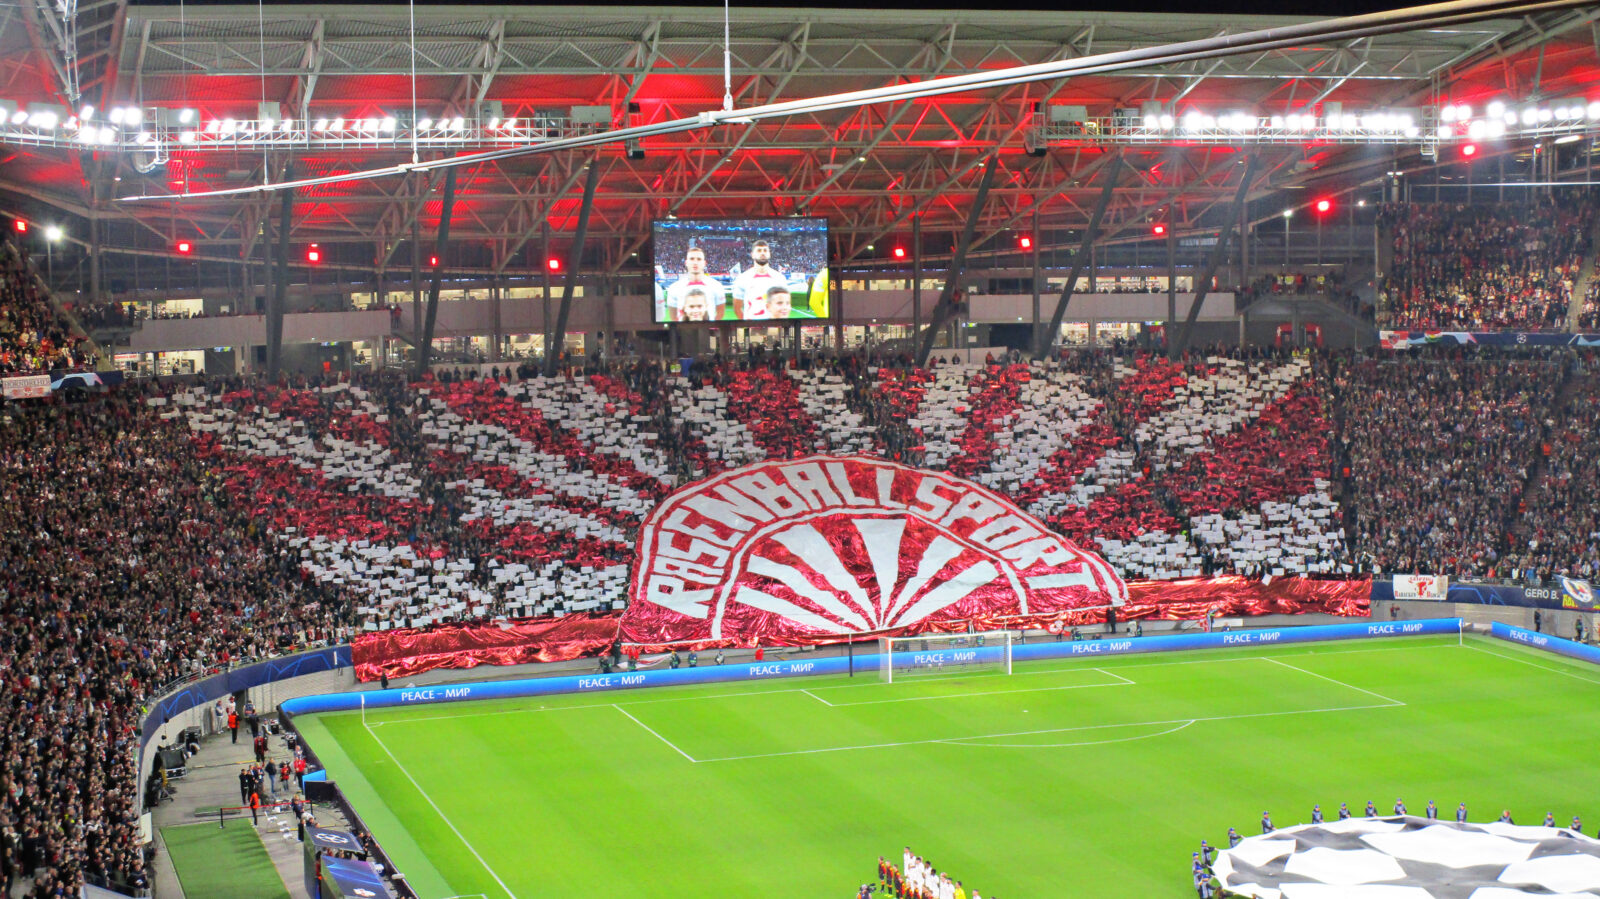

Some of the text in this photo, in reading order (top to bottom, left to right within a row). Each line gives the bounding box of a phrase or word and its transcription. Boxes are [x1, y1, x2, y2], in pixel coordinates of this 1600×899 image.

[646, 462, 1101, 619] RASENBALLSPORT
[1524, 588, 1560, 600] GERO B.
[1368, 625, 1394, 634] PEACE
[1509, 629, 1527, 641] PEACE
[1223, 633, 1251, 643] PEACE
[1072, 643, 1100, 653] PEACE
[914, 653, 944, 664] PEACE
[750, 665, 781, 676] PEACE
[579, 677, 611, 689] PEACE
[401, 690, 434, 702] PEACE
